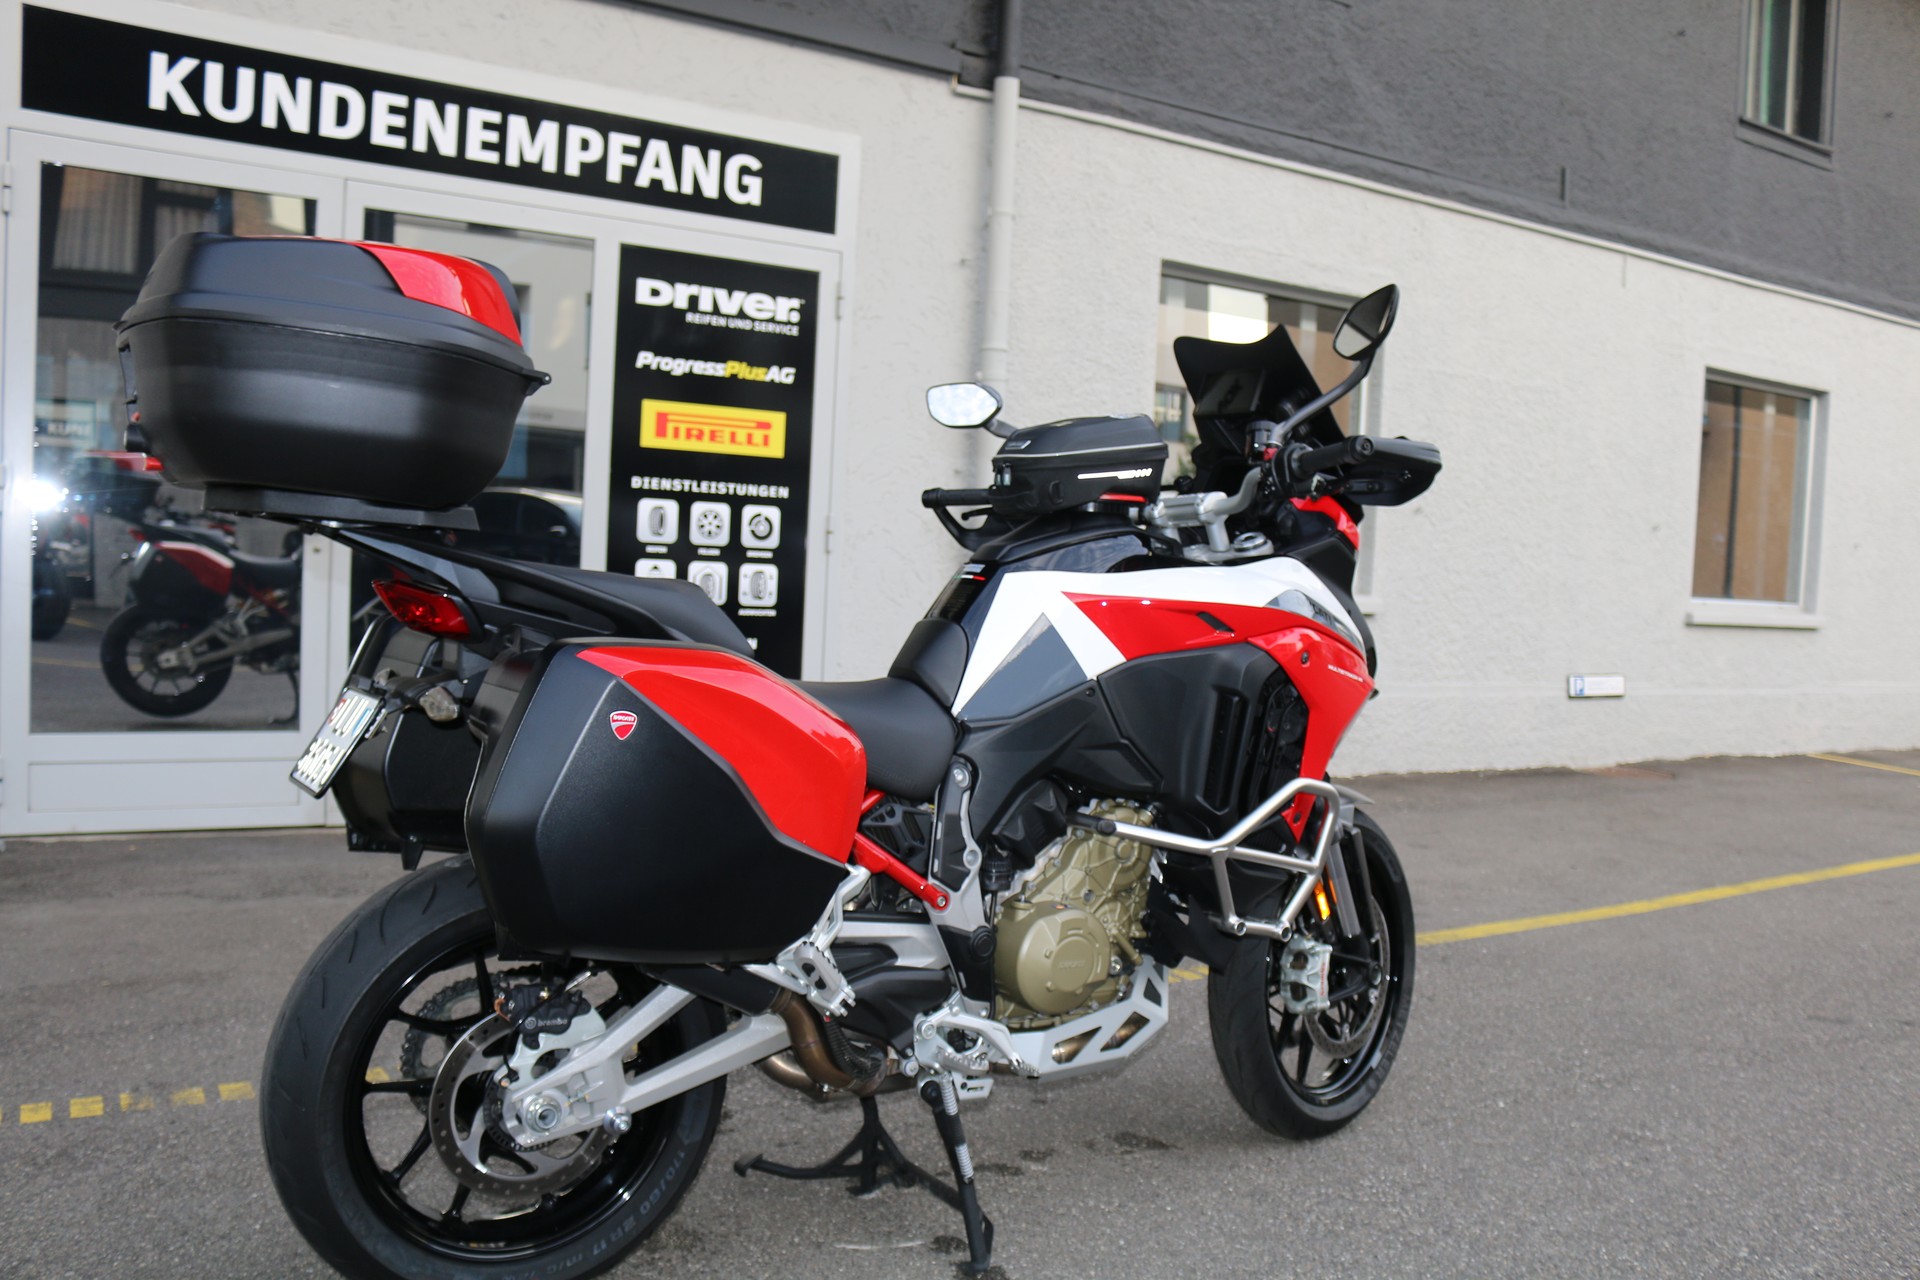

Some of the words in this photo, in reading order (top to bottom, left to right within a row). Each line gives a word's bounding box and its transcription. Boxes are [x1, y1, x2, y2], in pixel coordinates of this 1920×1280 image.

[147, 50, 764, 207] KUNDENEMPFANG
[685, 312, 728, 329] REIFEN
[729, 315, 753, 331] UND
[753, 320, 800, 337] SERVICE
[655, 411, 772, 448] PIRELLI
[631, 475, 790, 499] DIENSTLEISTUNGEN
